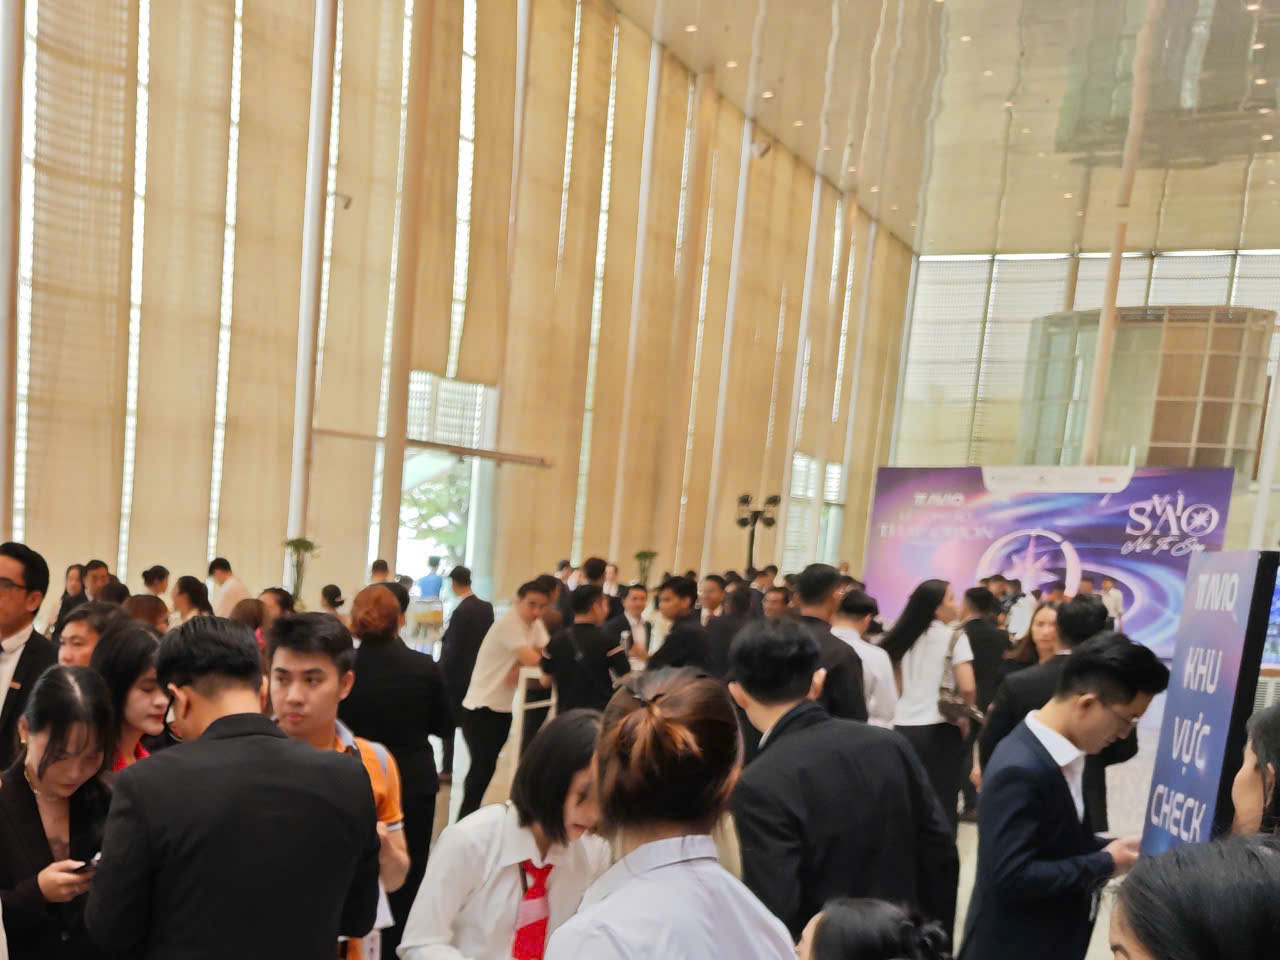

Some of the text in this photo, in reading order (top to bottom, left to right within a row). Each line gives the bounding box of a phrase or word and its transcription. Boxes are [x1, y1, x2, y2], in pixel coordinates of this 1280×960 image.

[1183, 647, 1223, 694] KHU
[1172, 712, 1211, 776] VỰC
[1150, 784, 1207, 843] CHECK
